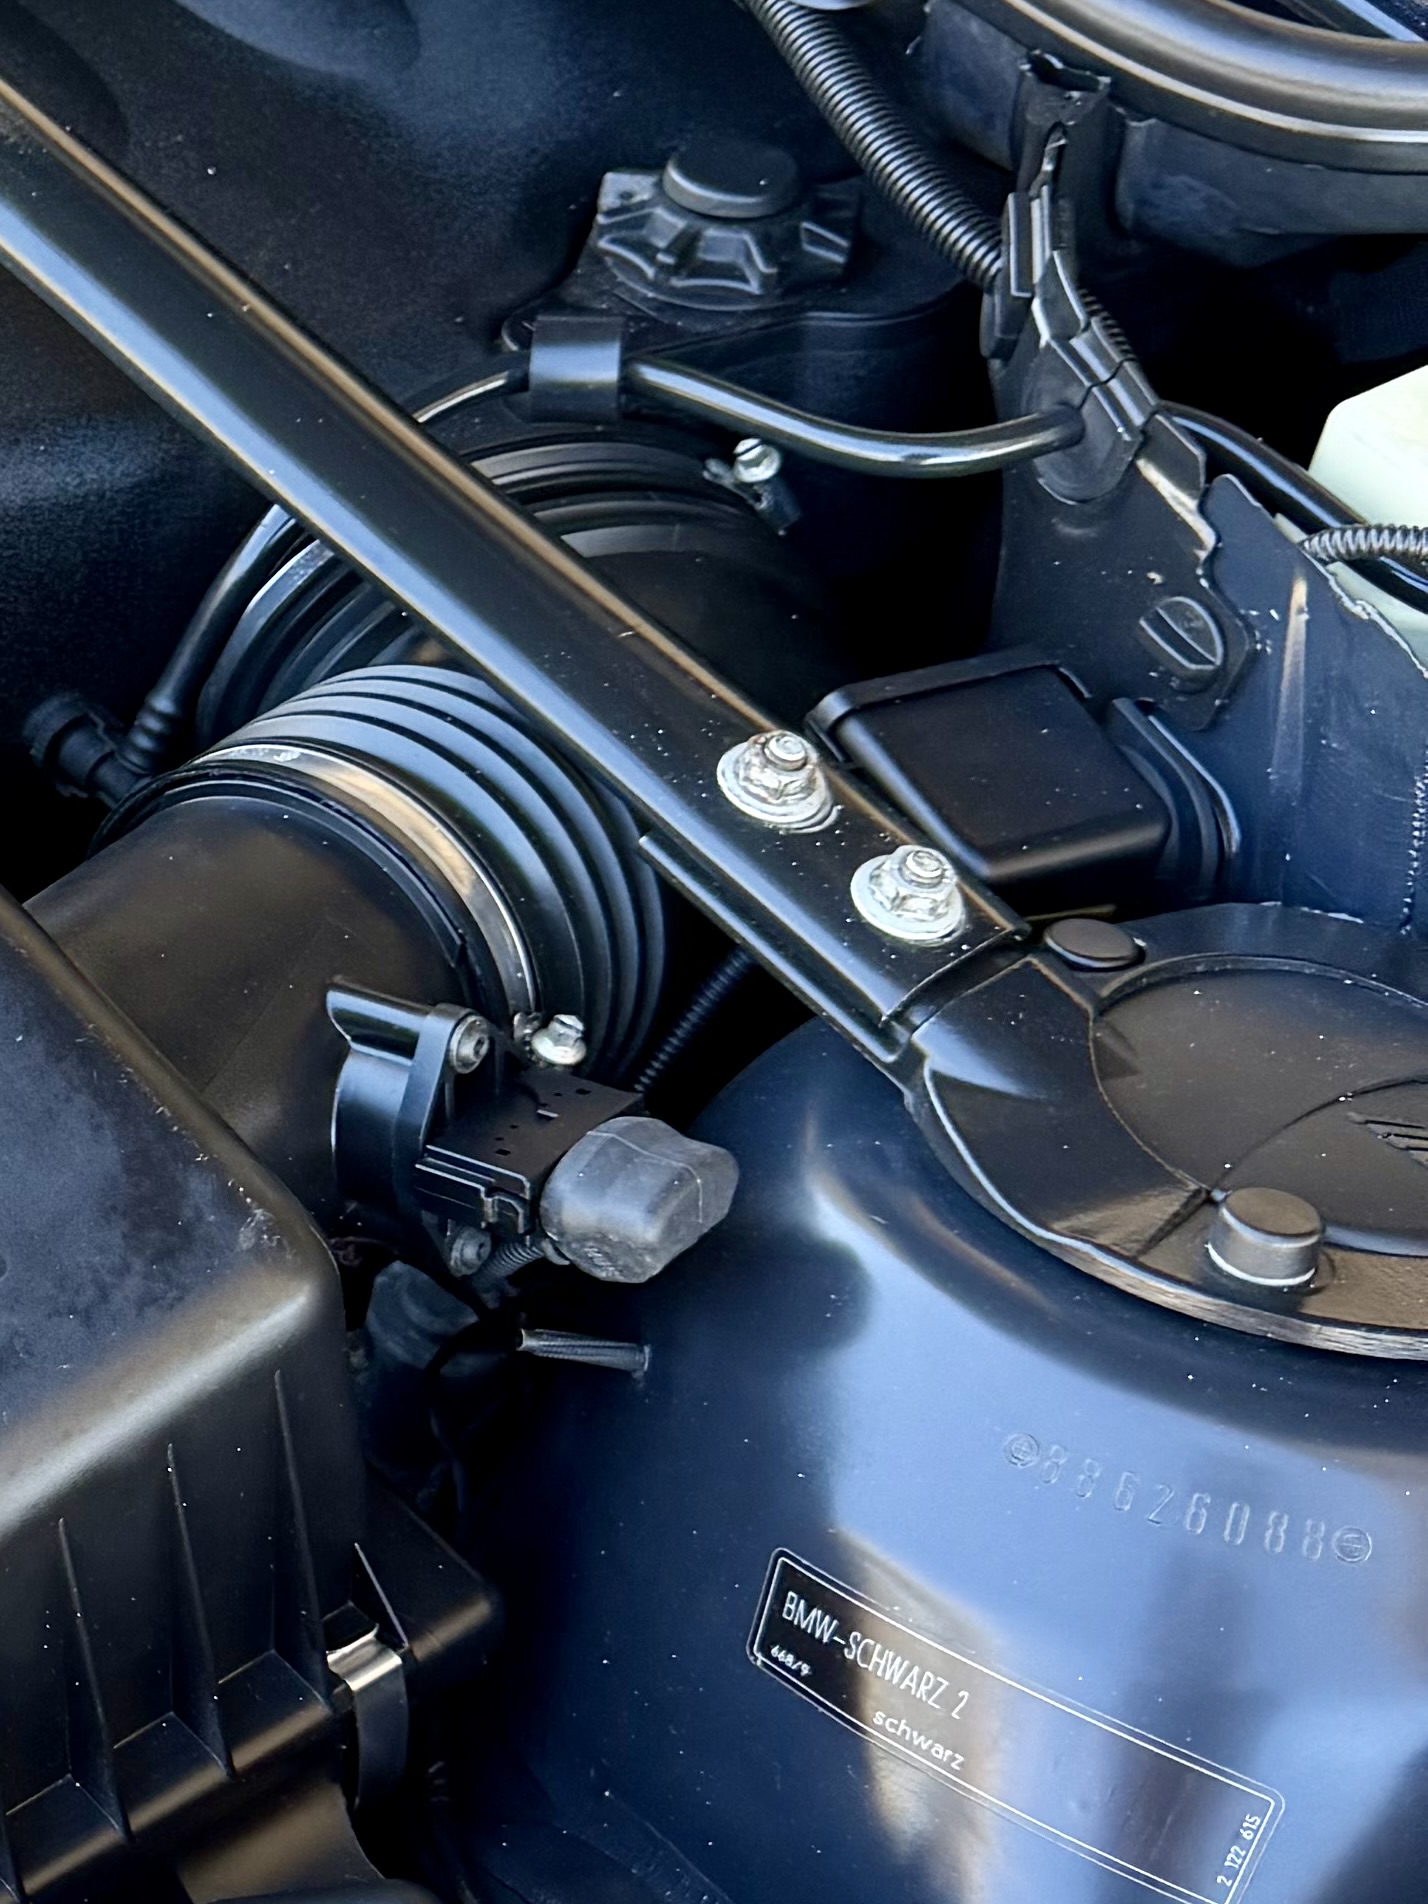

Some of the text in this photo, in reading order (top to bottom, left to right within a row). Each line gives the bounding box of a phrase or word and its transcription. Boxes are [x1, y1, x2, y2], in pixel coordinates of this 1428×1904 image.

[782, 1590, 969, 1719] BMW-SCHWARZ 2
[873, 1711, 964, 1770] schwarz
[1216, 1814, 1265, 1887] 2 122 615
